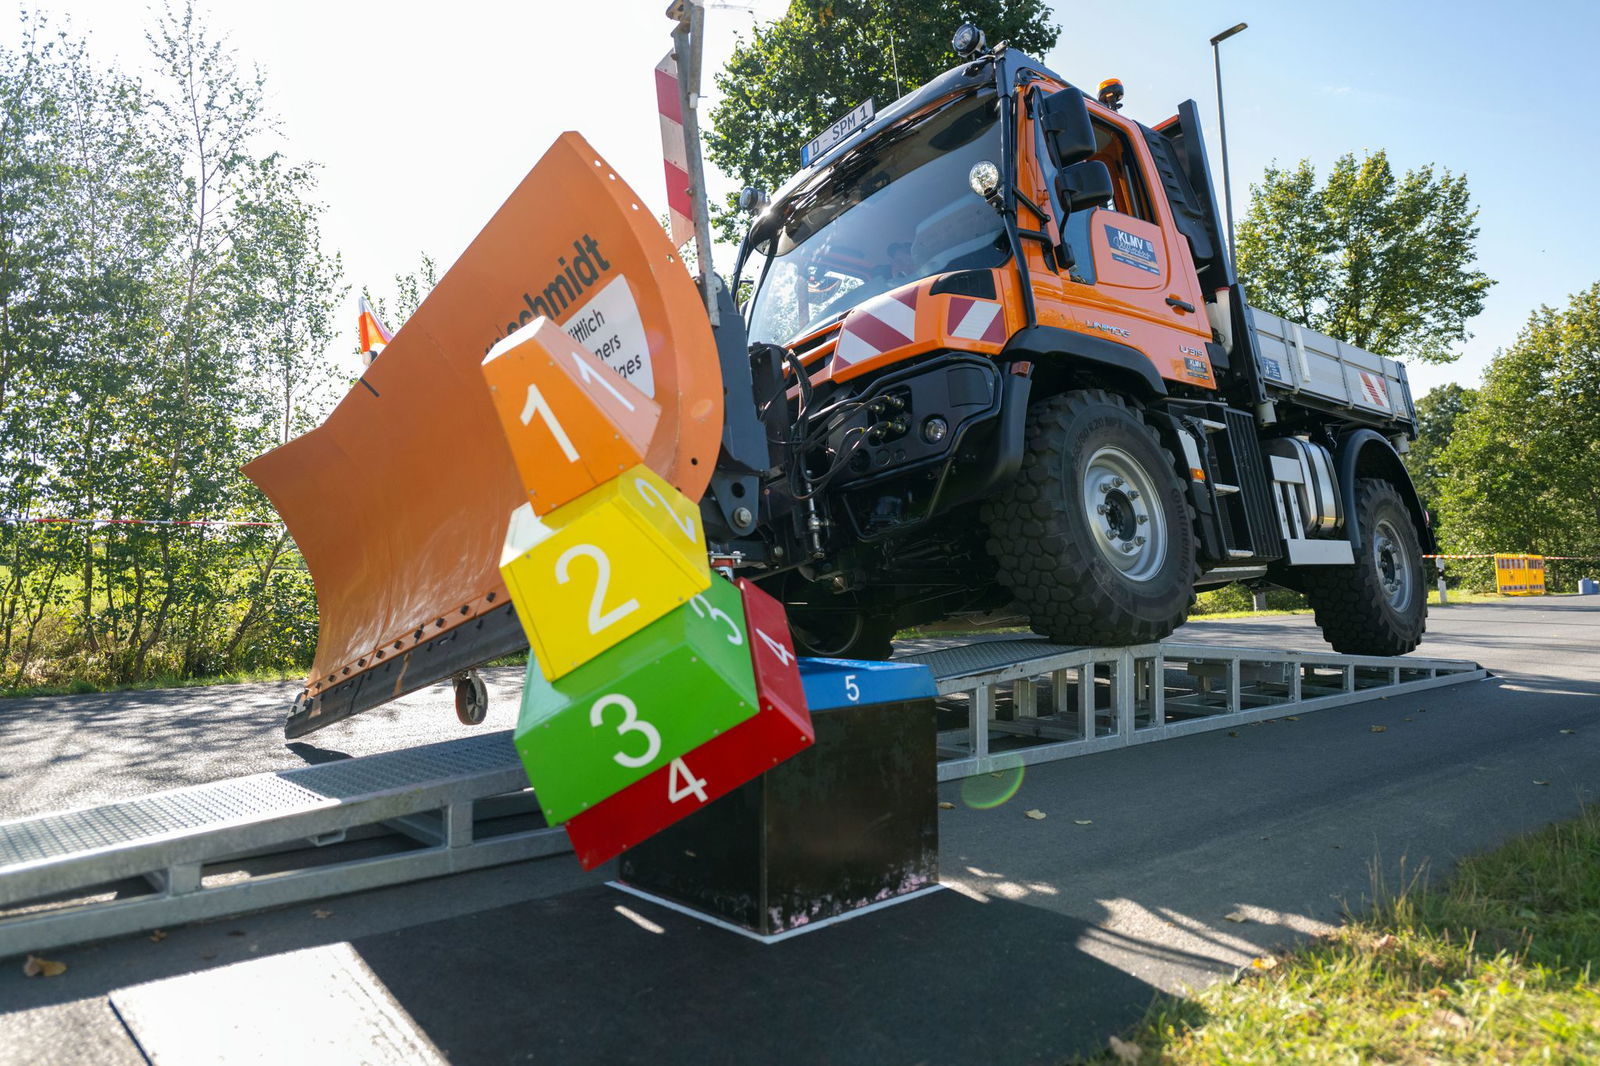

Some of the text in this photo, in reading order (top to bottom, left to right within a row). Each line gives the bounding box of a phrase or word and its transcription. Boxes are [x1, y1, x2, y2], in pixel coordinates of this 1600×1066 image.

[812, 140, 820, 157] D
[832, 112, 856, 141] SPM
[860, 104, 869, 122] 1
[1117, 230, 1143, 250] KLMV
[572, 351, 635, 412] 1
[520, 383, 580, 463] 1
[634, 477, 697, 544] 2
[555, 543, 640, 635] 2
[690, 593, 743, 646] 3
[755, 628, 795, 666] 4
[846, 675, 861, 701] 5
[590, 693, 661, 769] 3
[668, 757, 709, 804] 4
